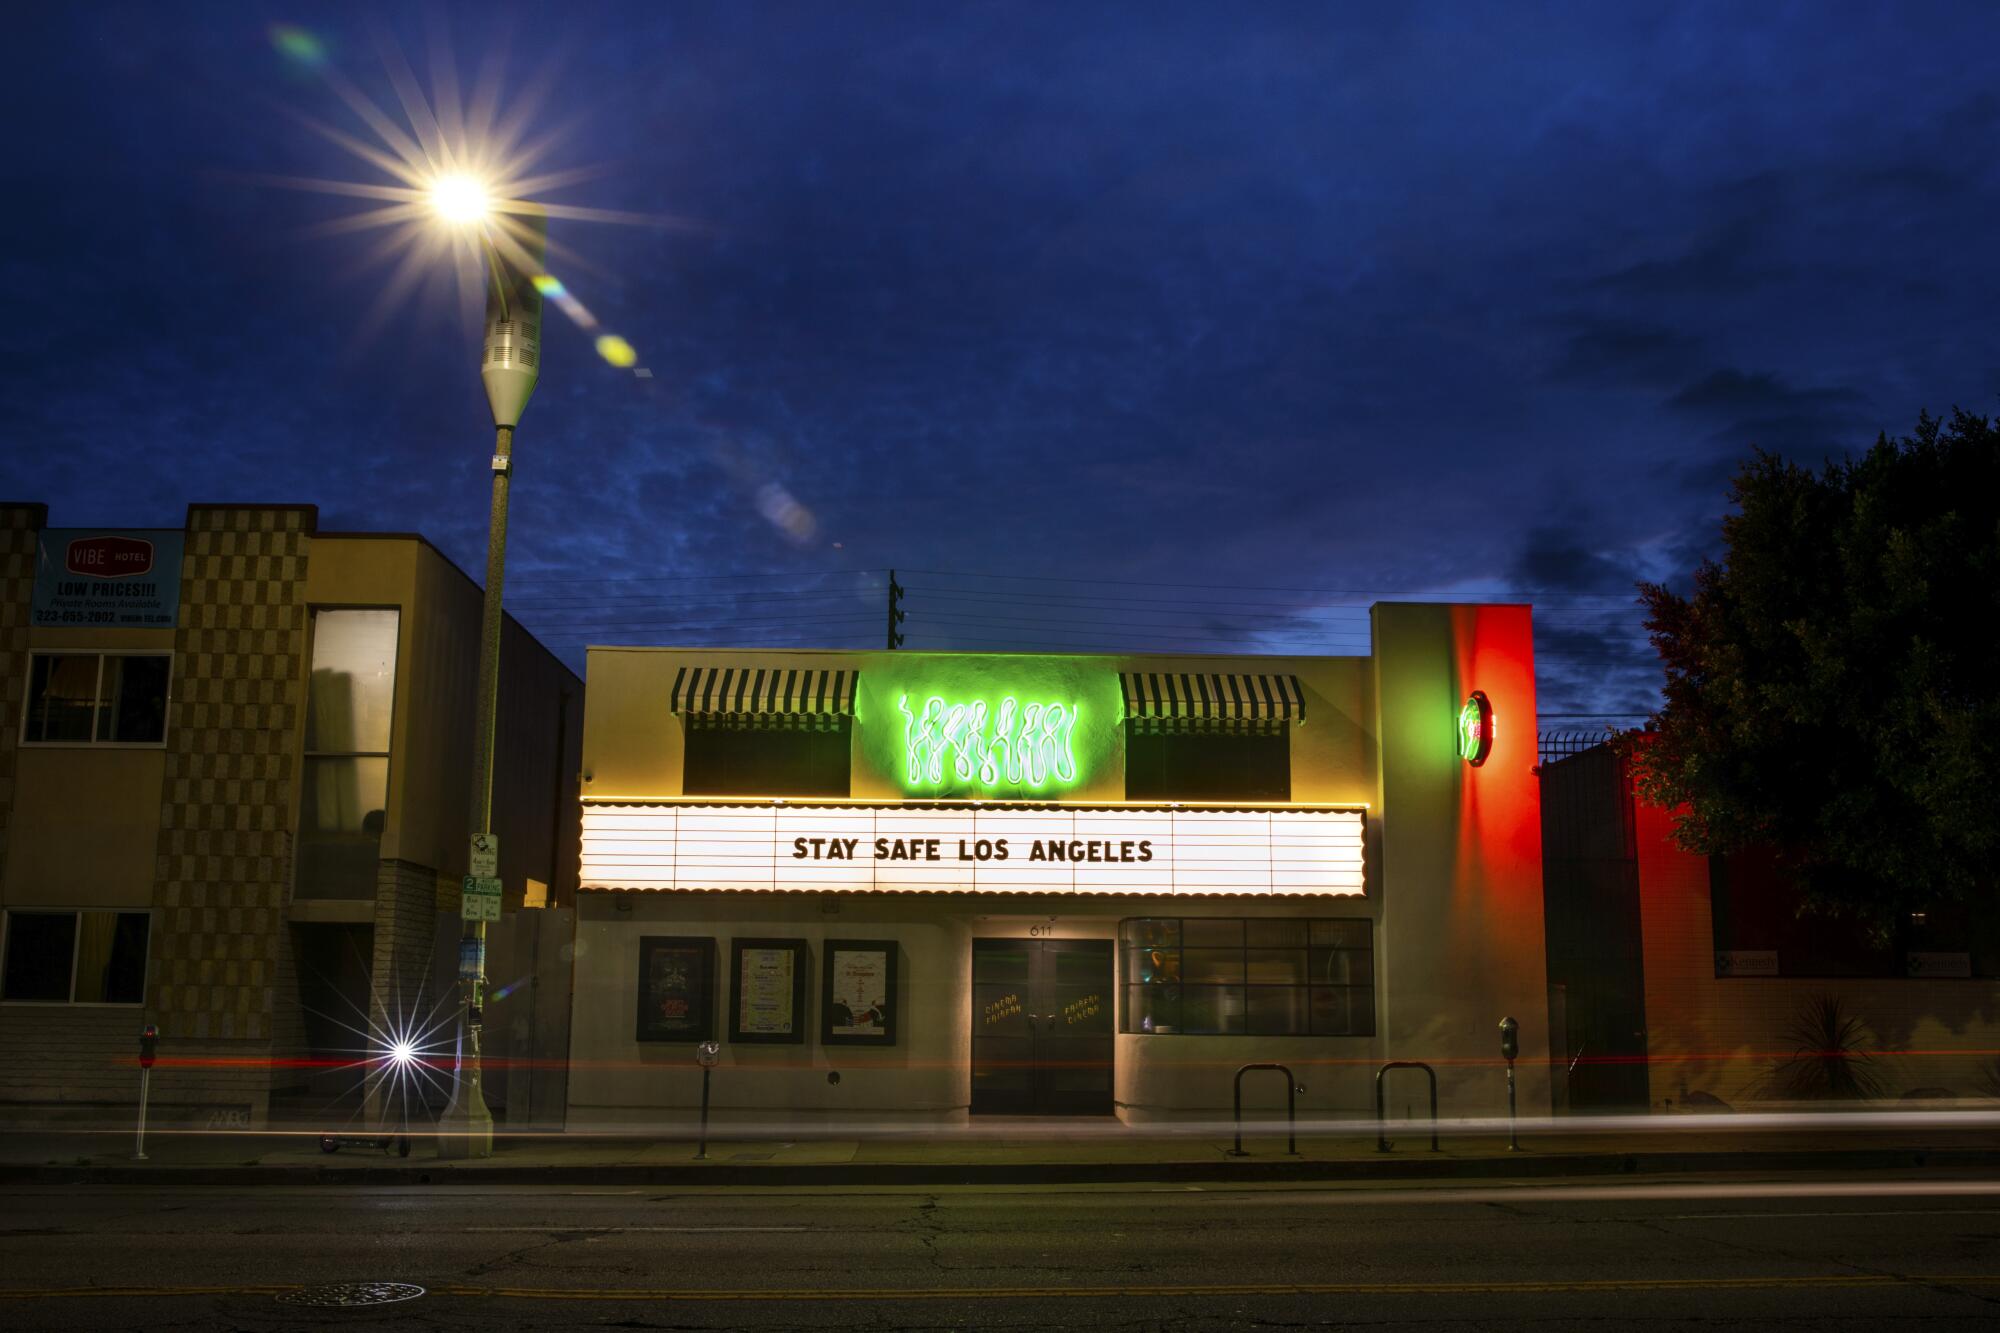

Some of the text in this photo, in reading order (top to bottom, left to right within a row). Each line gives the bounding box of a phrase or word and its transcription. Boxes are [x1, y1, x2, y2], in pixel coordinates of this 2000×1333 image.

[73, 548, 147, 565] VIBE HOTEL
[57, 582, 157, 597] LOW PRICES!!!
[50, 598, 161, 609] Private Rooms Available
[792, 837, 1153, 863] STAY SAFE LOS ANGELES
[466, 878, 474, 889] 2
[1030, 925, 1051, 937] 611
[1729, 955, 1777, 969] Kennedy
[1920, 956, 1969, 969] Kennedy
[985, 994, 1017, 1014] CINEMA
